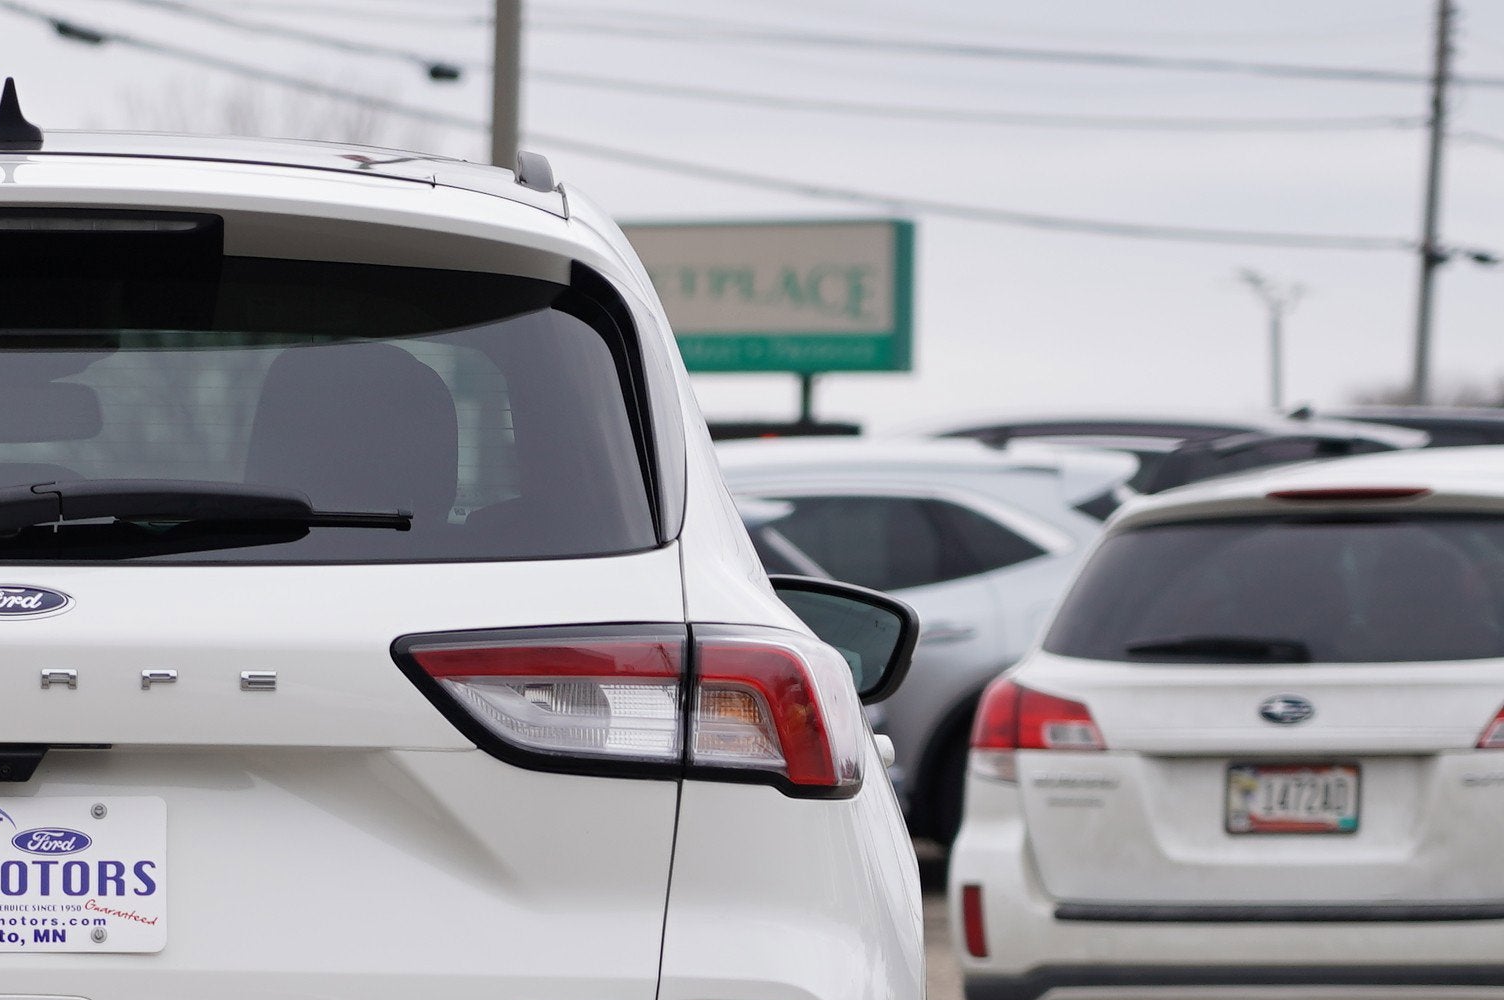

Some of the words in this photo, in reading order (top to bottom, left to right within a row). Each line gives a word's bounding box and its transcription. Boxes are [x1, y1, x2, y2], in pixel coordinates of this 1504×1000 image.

[27, 831, 77, 852] Ford
[31, 904, 56, 912] SINCE
[60, 904, 82, 912] 1950
[84, 898, 158, 926] Guaranteed
[33, 929, 66, 943] MN
